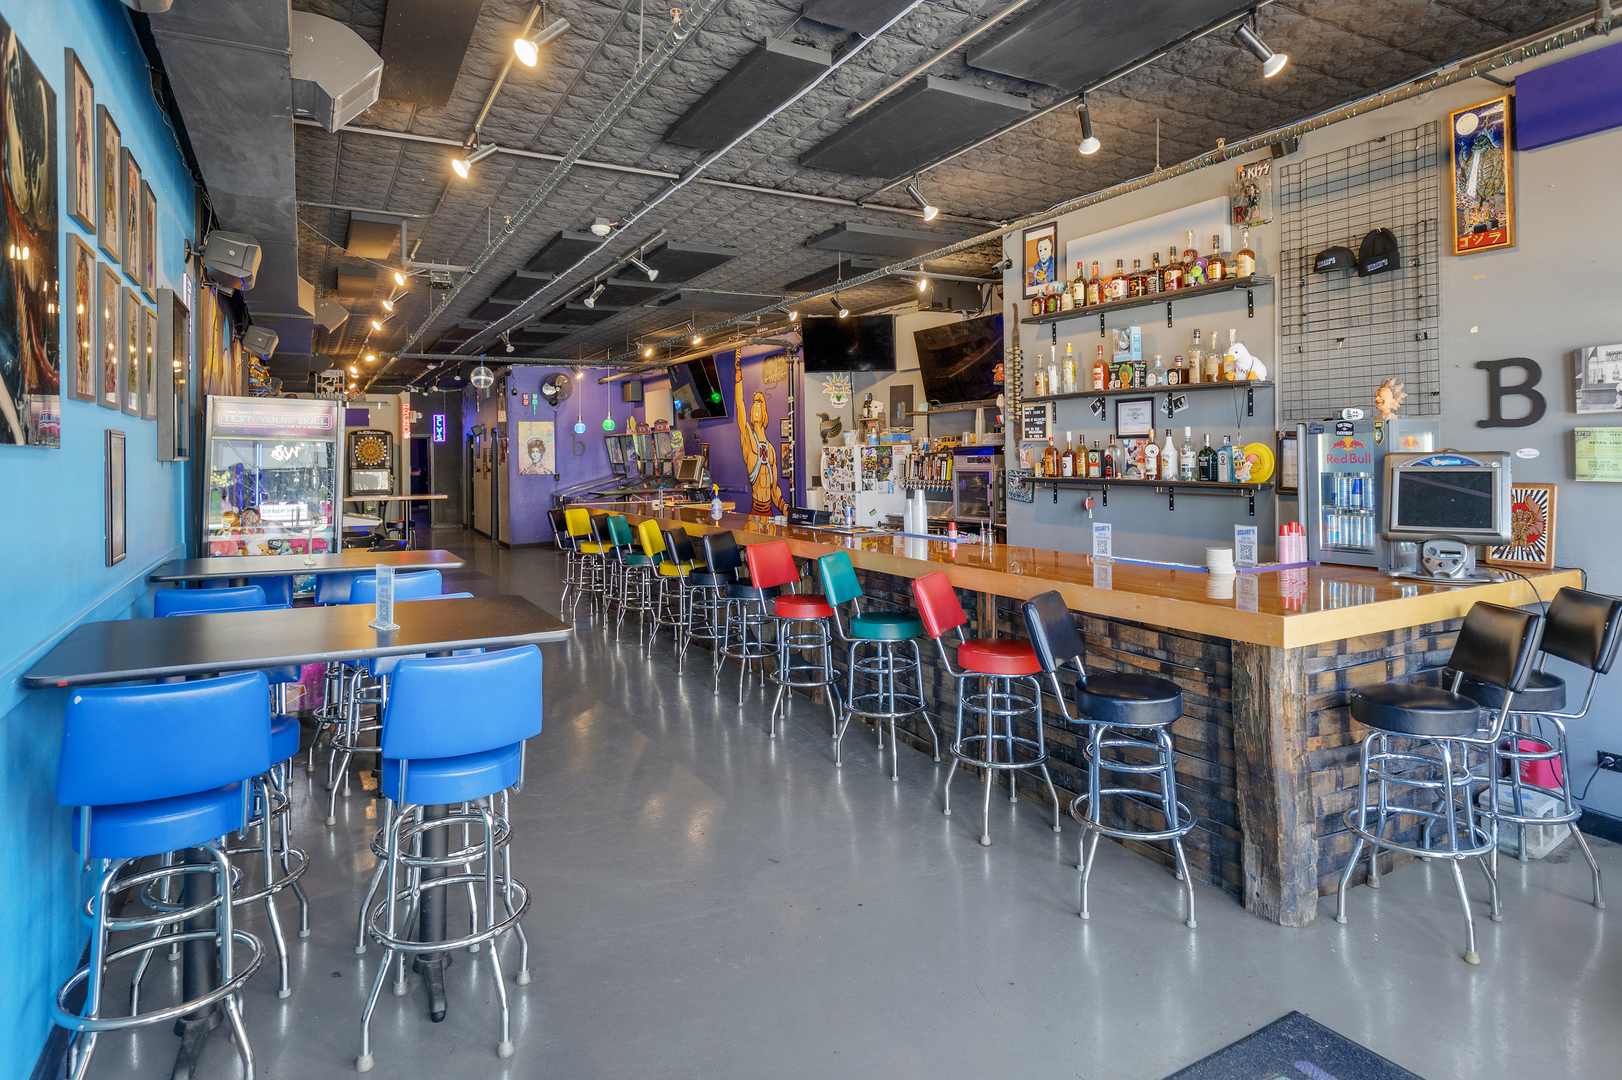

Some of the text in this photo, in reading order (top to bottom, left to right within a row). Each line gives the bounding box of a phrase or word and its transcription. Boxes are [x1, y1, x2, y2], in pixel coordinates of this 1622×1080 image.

[1247, 164, 1270, 179] KISS
[1234, 207, 1246, 223] K
[1460, 231, 1502, 248] ゴジラ
[1477, 357, 1546, 428] B
[223, 415, 328, 426] TEST YOUR SKILL
[570, 434, 586, 457] b
[1327, 453, 1371, 464] Red Bull
